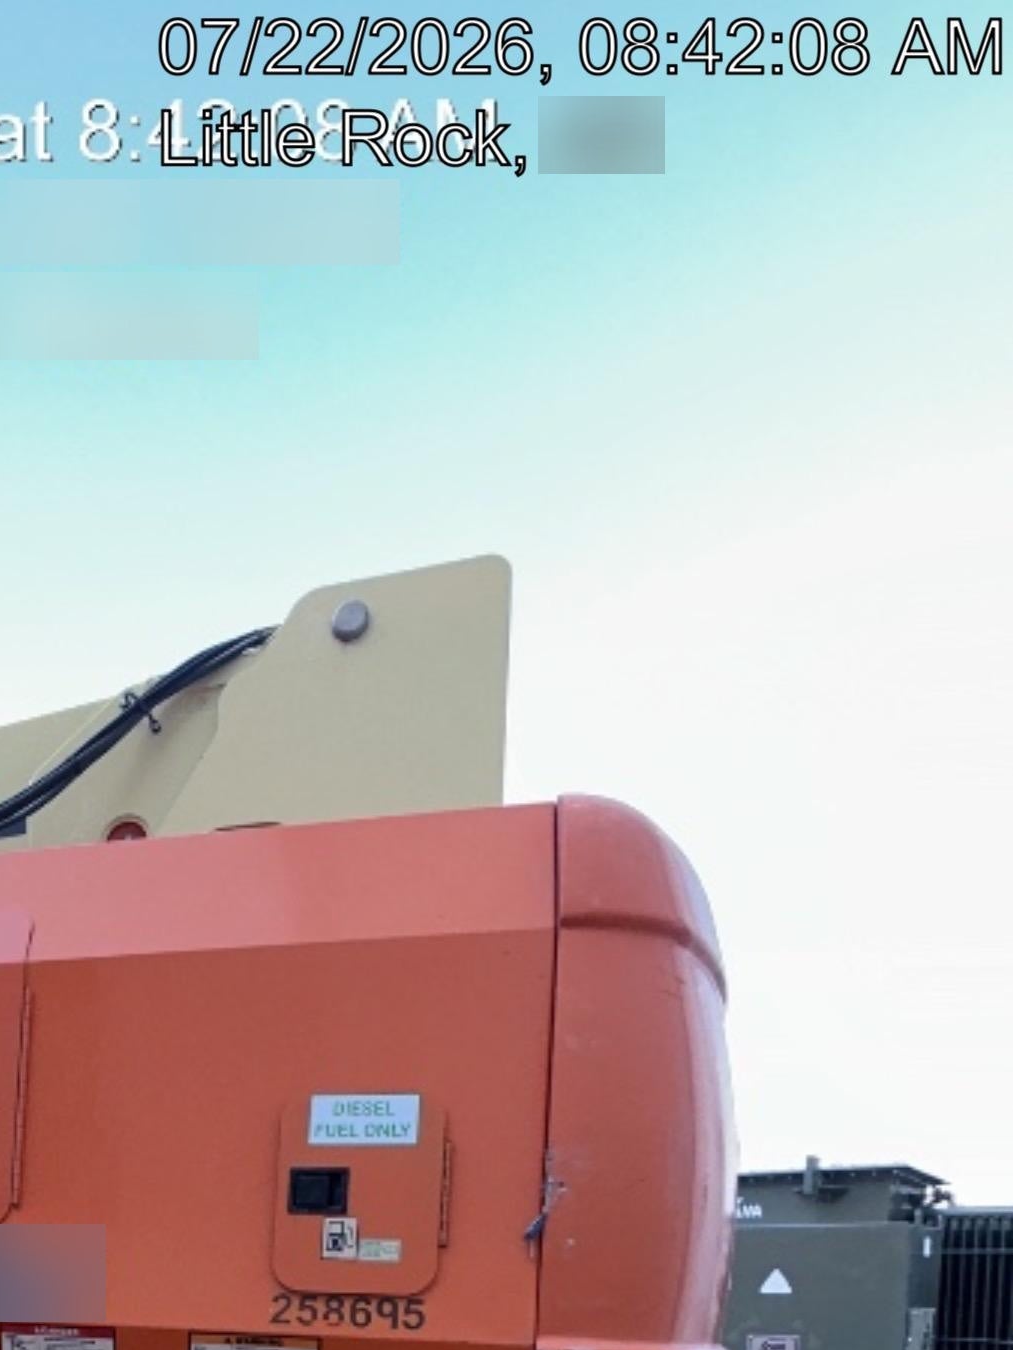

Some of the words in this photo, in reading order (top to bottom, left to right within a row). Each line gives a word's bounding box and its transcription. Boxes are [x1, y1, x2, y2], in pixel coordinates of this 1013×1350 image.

[332, 1100, 396, 1118] DIESEL
[314, 1122, 359, 1139] FUEL
[364, 1122, 413, 1139] ONLY
[270, 1294, 426, 1331] 258695
